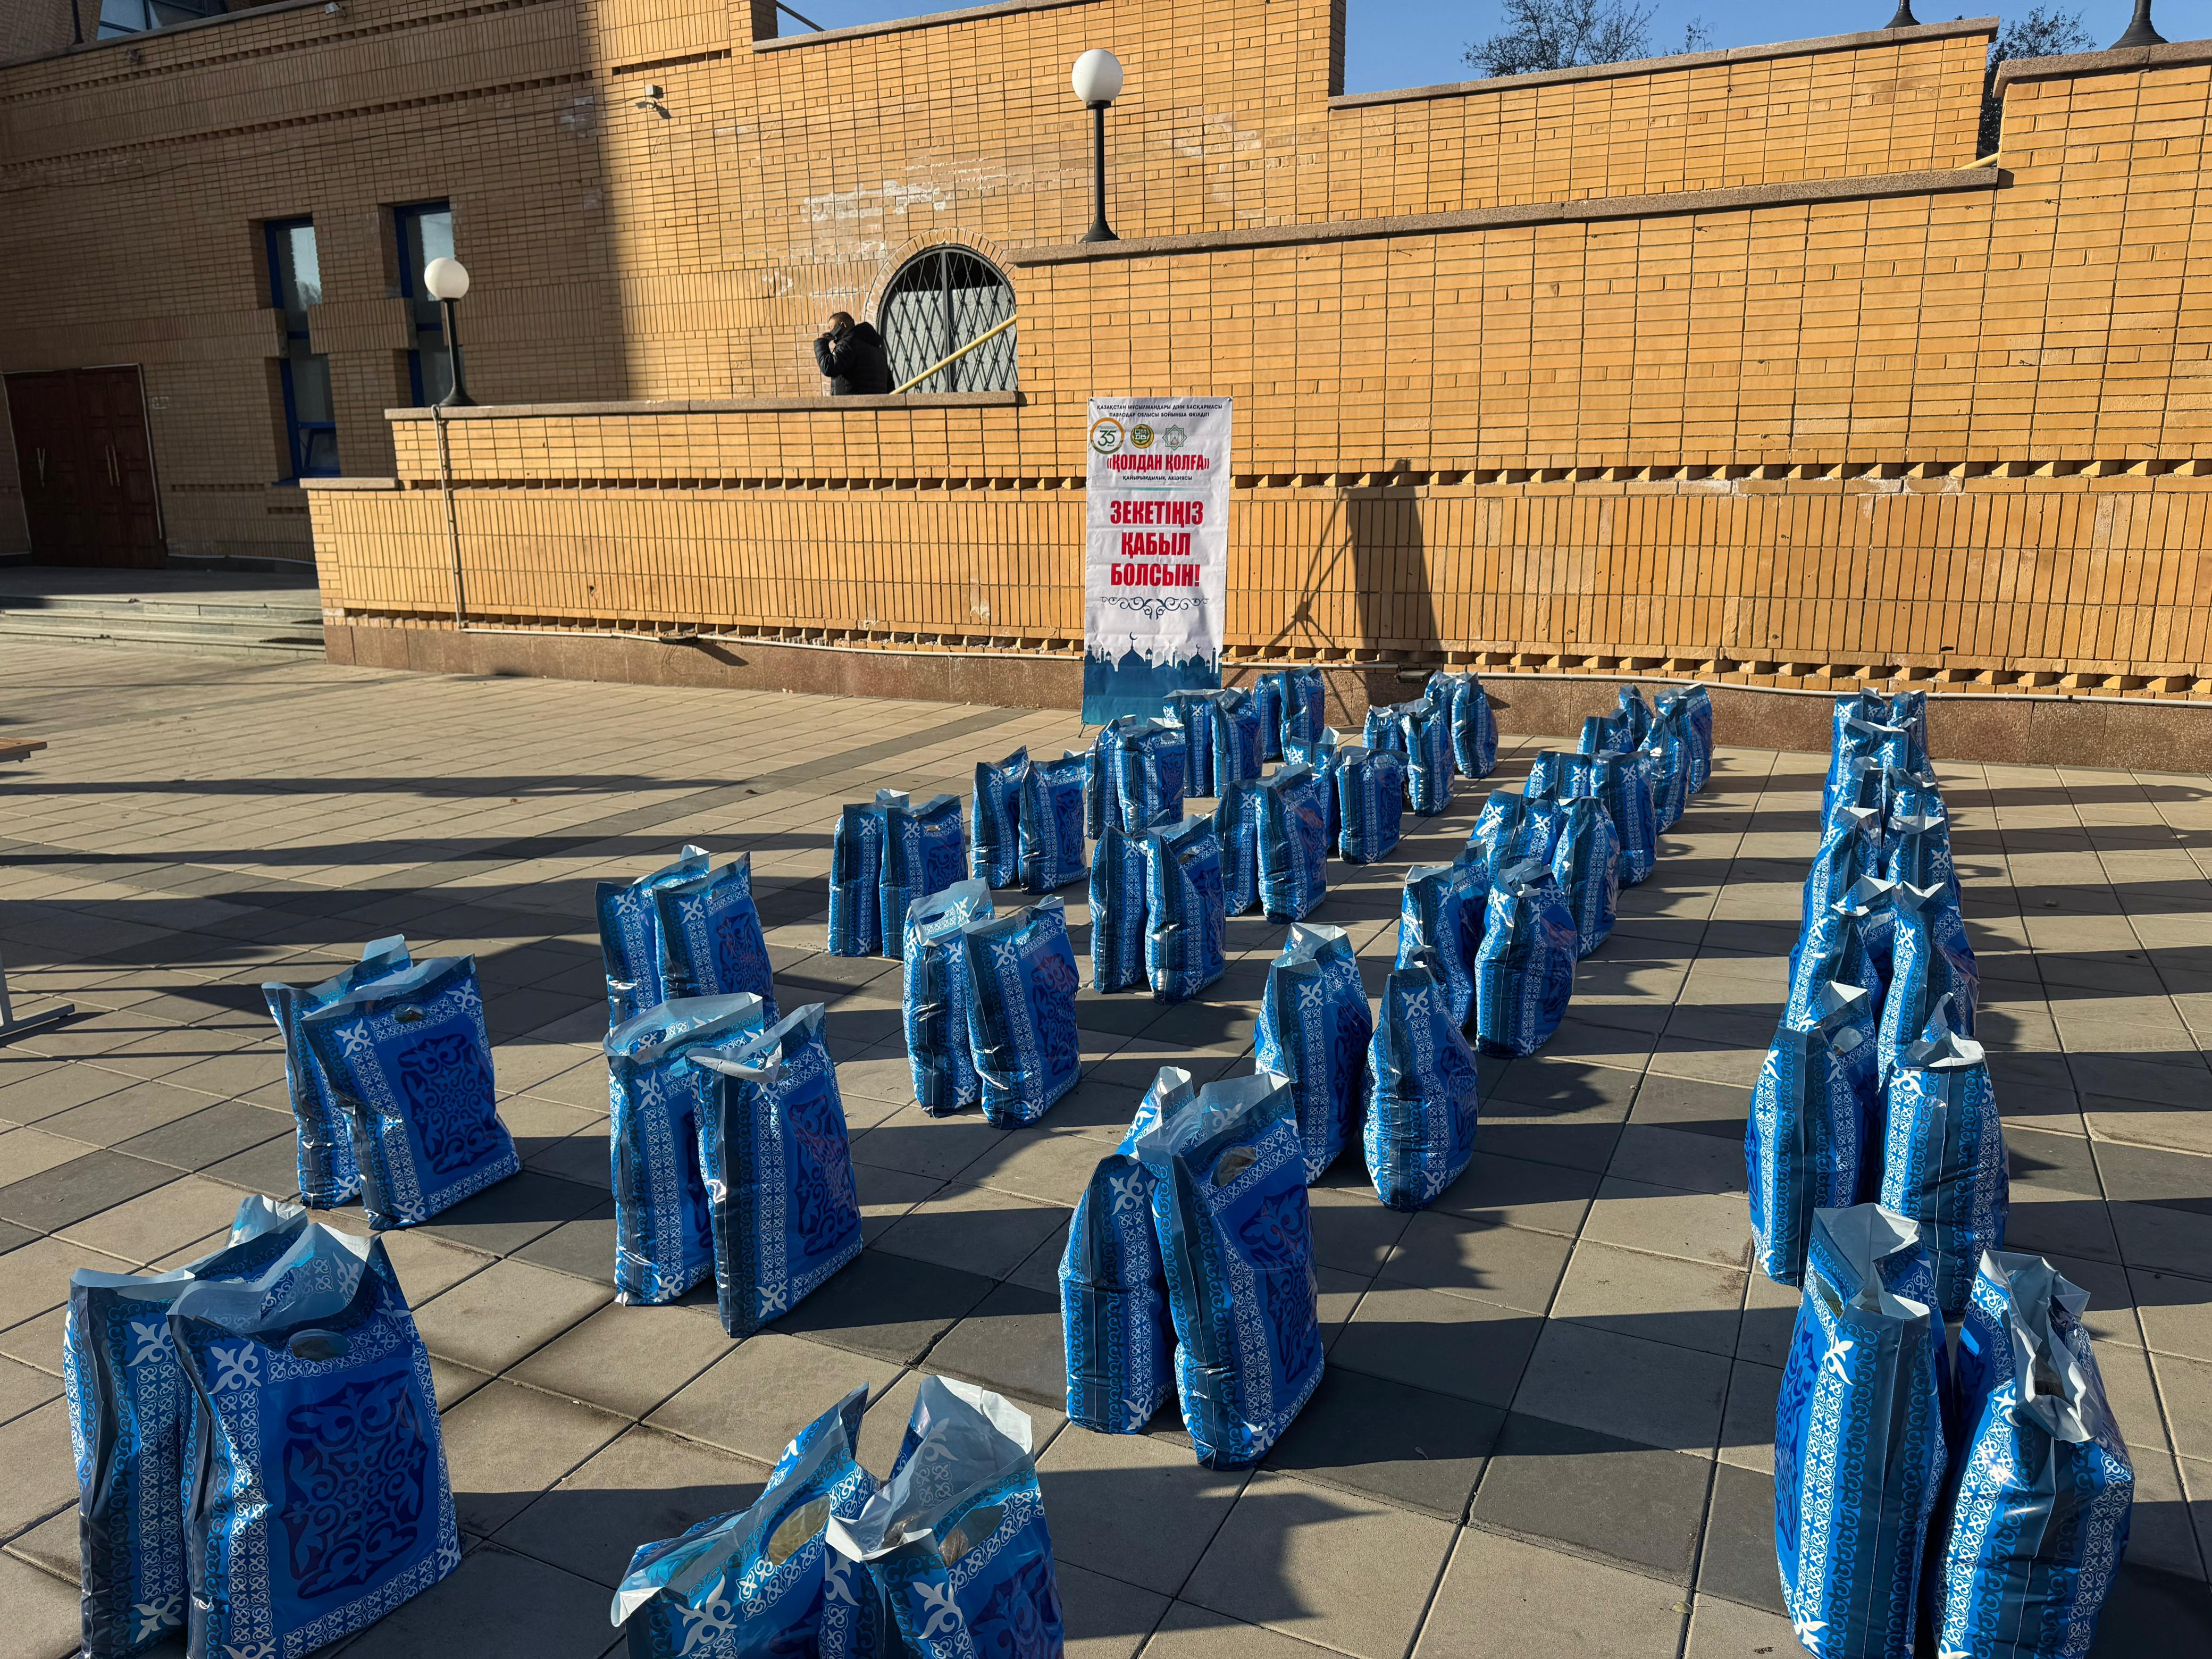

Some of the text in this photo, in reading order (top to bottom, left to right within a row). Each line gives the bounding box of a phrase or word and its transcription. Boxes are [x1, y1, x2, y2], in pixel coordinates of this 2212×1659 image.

[1097, 430, 1117, 446] 35
[1110, 500, 1204, 528] ЗЕКЕТІҢІЗ
[1121, 532, 1191, 559] ҚАБЫЛ
[1110, 563, 1201, 587] БОЛСЫН!
